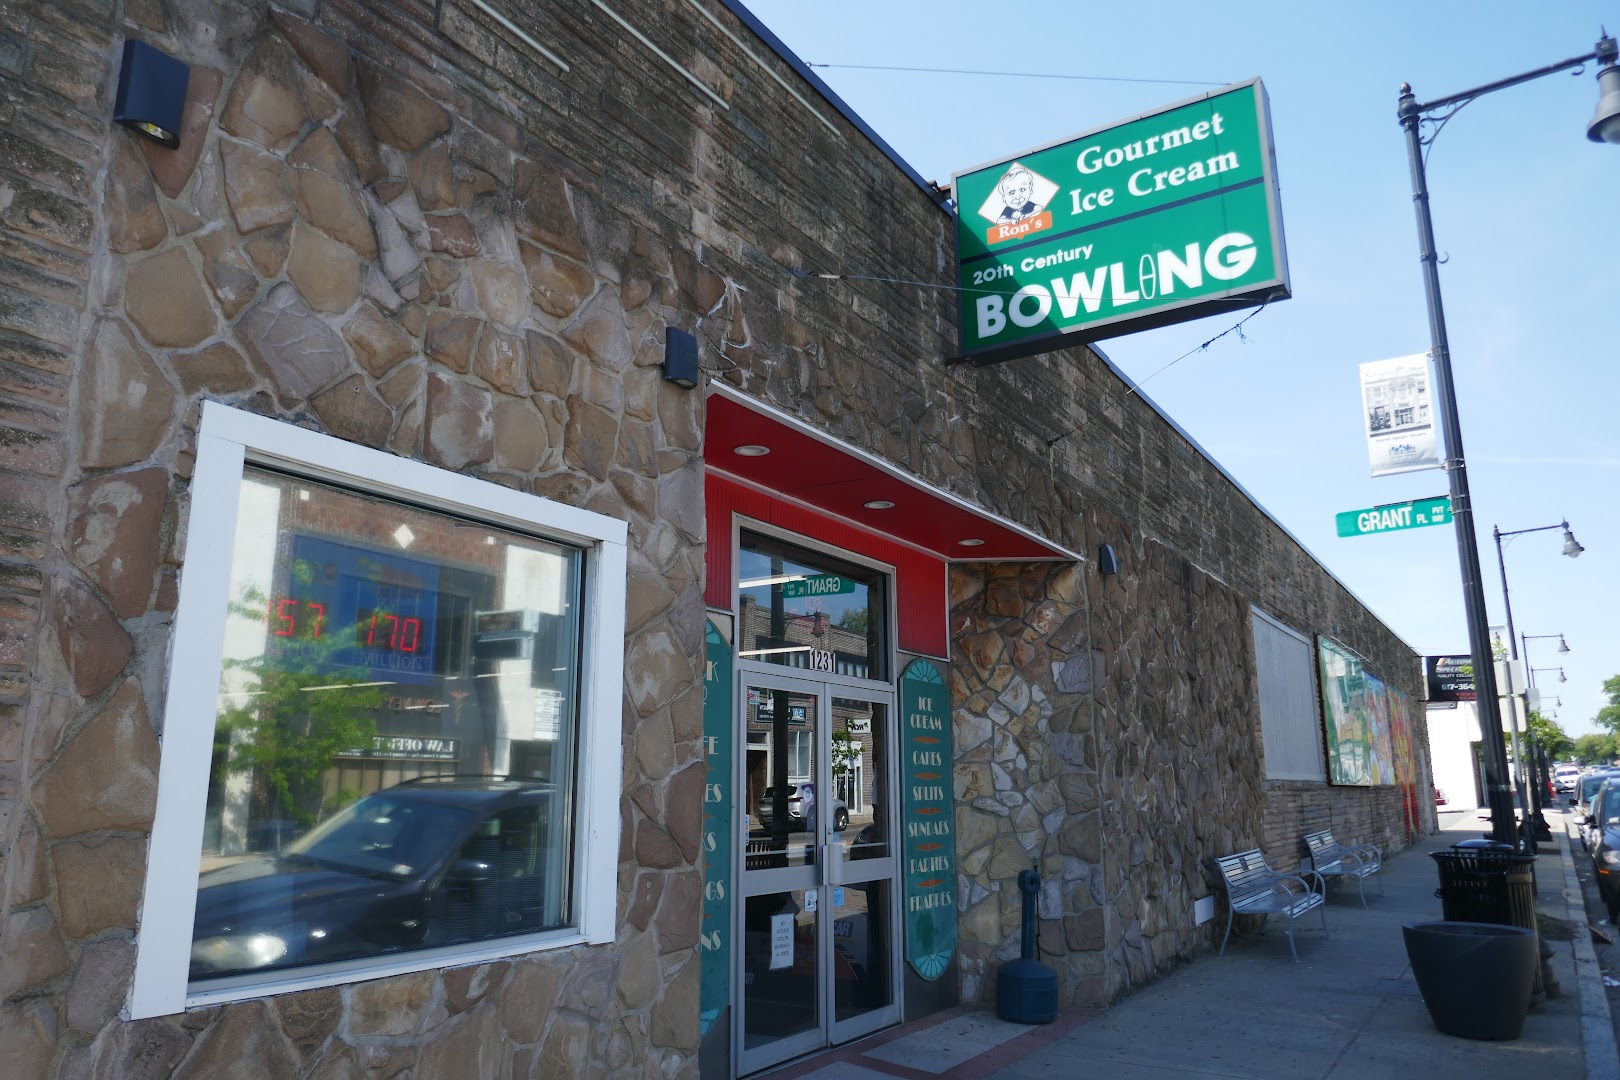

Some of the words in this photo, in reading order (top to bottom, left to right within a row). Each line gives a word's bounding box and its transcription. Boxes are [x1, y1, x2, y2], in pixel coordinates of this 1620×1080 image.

[1076, 112, 1224, 175] Gourmet
[1069, 186, 1114, 216] Ice
[1127, 151, 1240, 196] Cream
[998, 218, 1043, 240] Ron's
[973, 264, 1014, 286] 20th
[1020, 243, 1094, 273] Century
[975, 232, 1257, 340] BOWLING
[1357, 507, 1412, 532] GRANT
[1416, 514, 1428, 525] PL
[1431, 506, 1444, 515] PVT
[367, 614, 420, 652] 170
[810, 651, 835, 673] 1231
[918, 696, 933, 711] ICE
[910, 714, 942, 730] CREAM
[912, 750, 942, 766] CAKES
[912, 785, 944, 801] SPLITS
[908, 820, 949, 838] SUNDAES
[910, 856, 949, 874] PARTIES
[910, 890, 952, 912] FRAPPES
